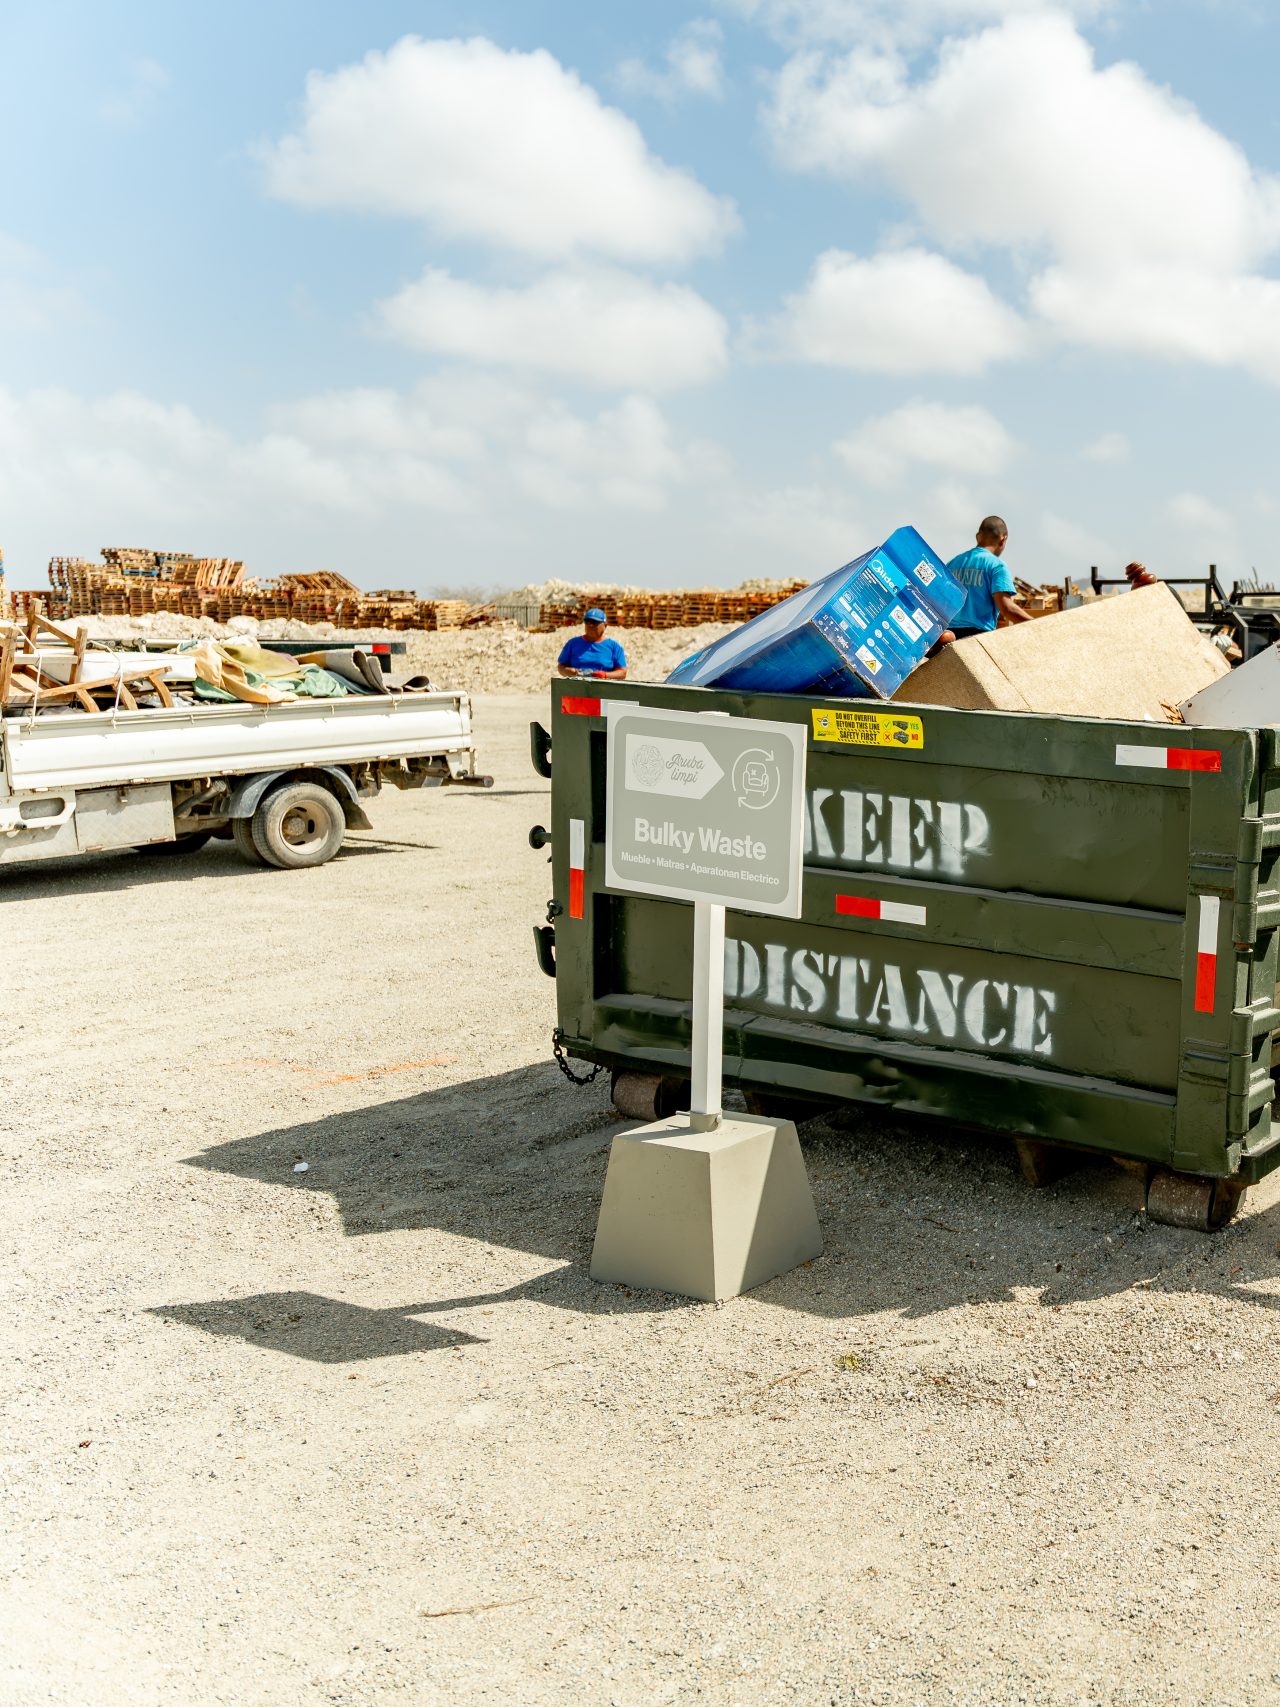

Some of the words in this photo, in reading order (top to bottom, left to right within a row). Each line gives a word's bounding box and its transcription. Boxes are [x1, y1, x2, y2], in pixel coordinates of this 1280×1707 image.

[836, 720, 855, 728] BEYOND
[854, 714, 877, 722] OVERFILL
[840, 731, 859, 739] SAFETY
[861, 732, 877, 741] FIRST
[665, 753, 705, 770] Aruba
[671, 768, 698, 785] limpi
[634, 817, 695, 854] Bulky
[698, 826, 767, 861] Waste
[803, 787, 992, 875] KEEP
[621, 851, 651, 865] Mueble
[656, 857, 685, 870] Matras
[690, 862, 740, 879] Aparatonan
[740, 870, 780, 886] Electrico
[724, 937, 1055, 1055] DISTANCE
